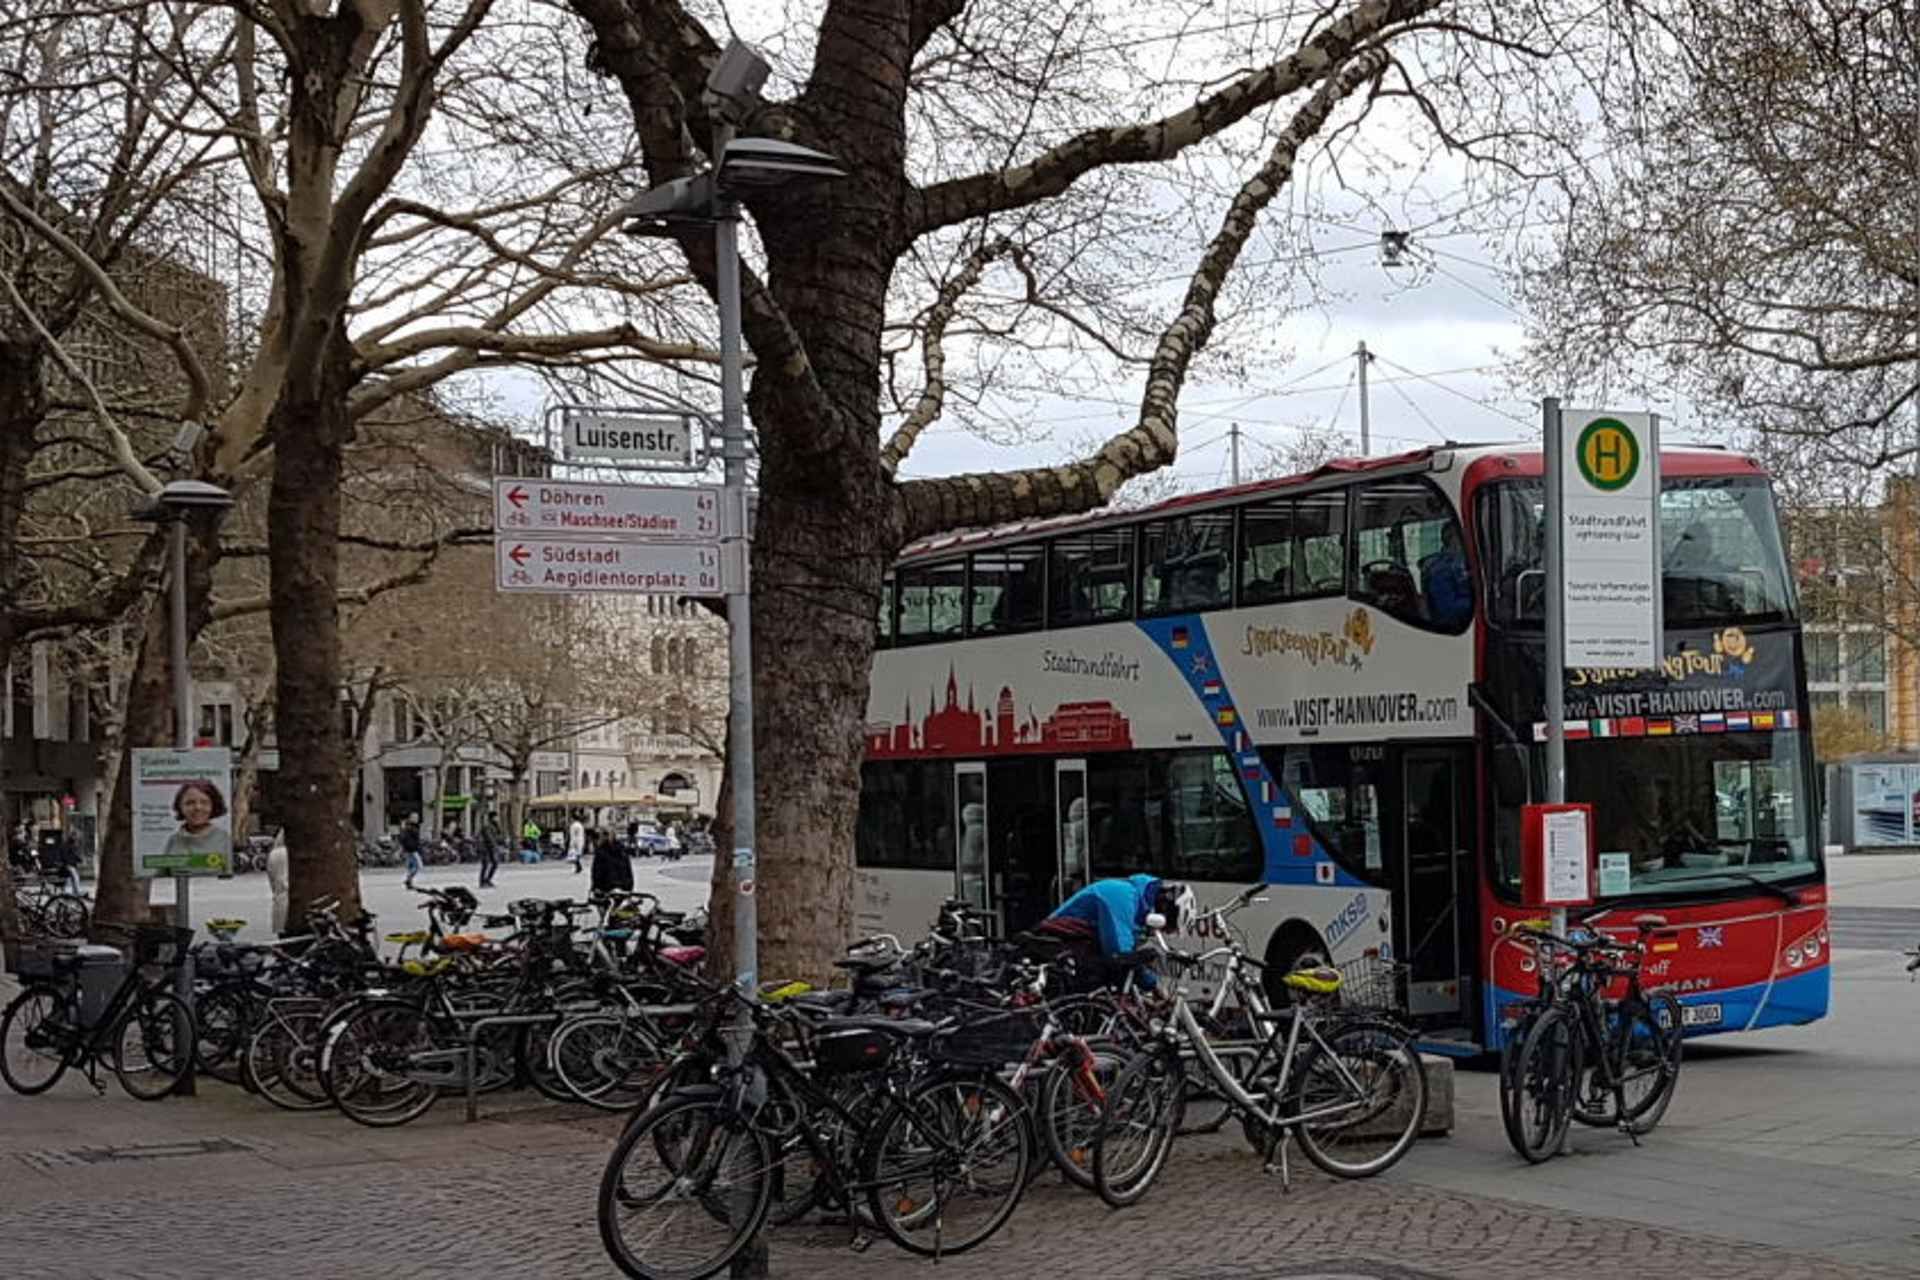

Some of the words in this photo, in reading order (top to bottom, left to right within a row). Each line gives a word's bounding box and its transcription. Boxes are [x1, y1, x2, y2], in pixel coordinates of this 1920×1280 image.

[575, 422, 680, 452] Luisenstr.
[1595, 433, 1621, 475] H
[540, 487, 605, 506] Döhren
[542, 547, 620, 565] Südstadt
[543, 567, 687, 588] Aegidientorplatz
[1042, 649, 1140, 681] Stadtrundfahrt
[1256, 693, 1458, 728] www.VISIT-HANNOVER.com
